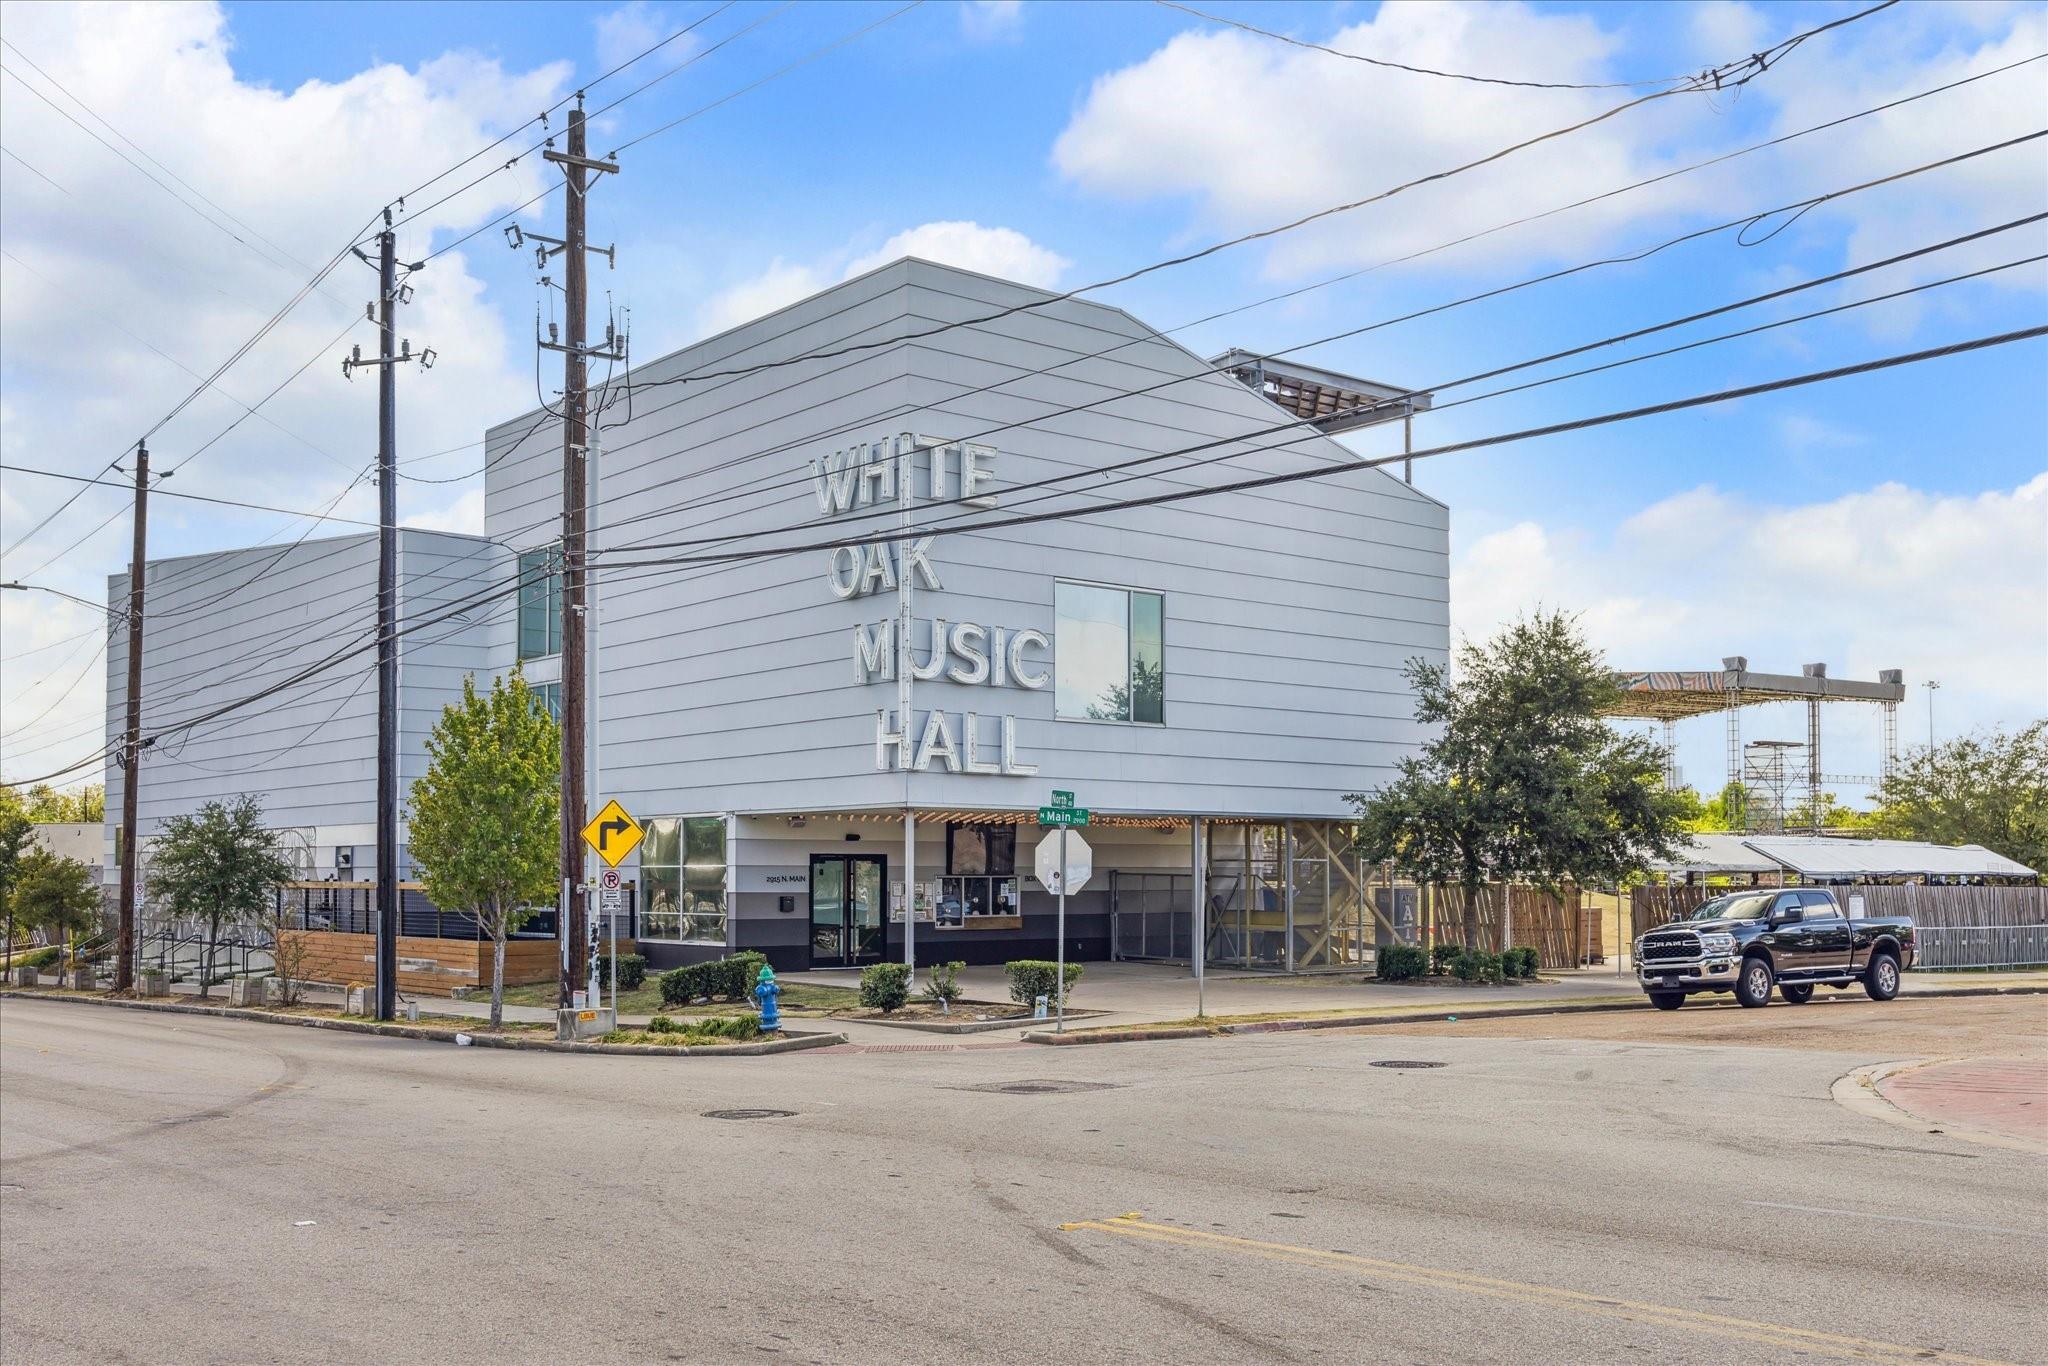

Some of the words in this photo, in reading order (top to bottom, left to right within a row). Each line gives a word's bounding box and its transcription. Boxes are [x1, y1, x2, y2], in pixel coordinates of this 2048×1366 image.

[808, 431, 999, 515] WHITE
[826, 527, 945, 600] OAK
[853, 618, 1052, 690] MUSIC
[875, 708, 1041, 776] HALL
[1047, 811, 1071, 822] Main
